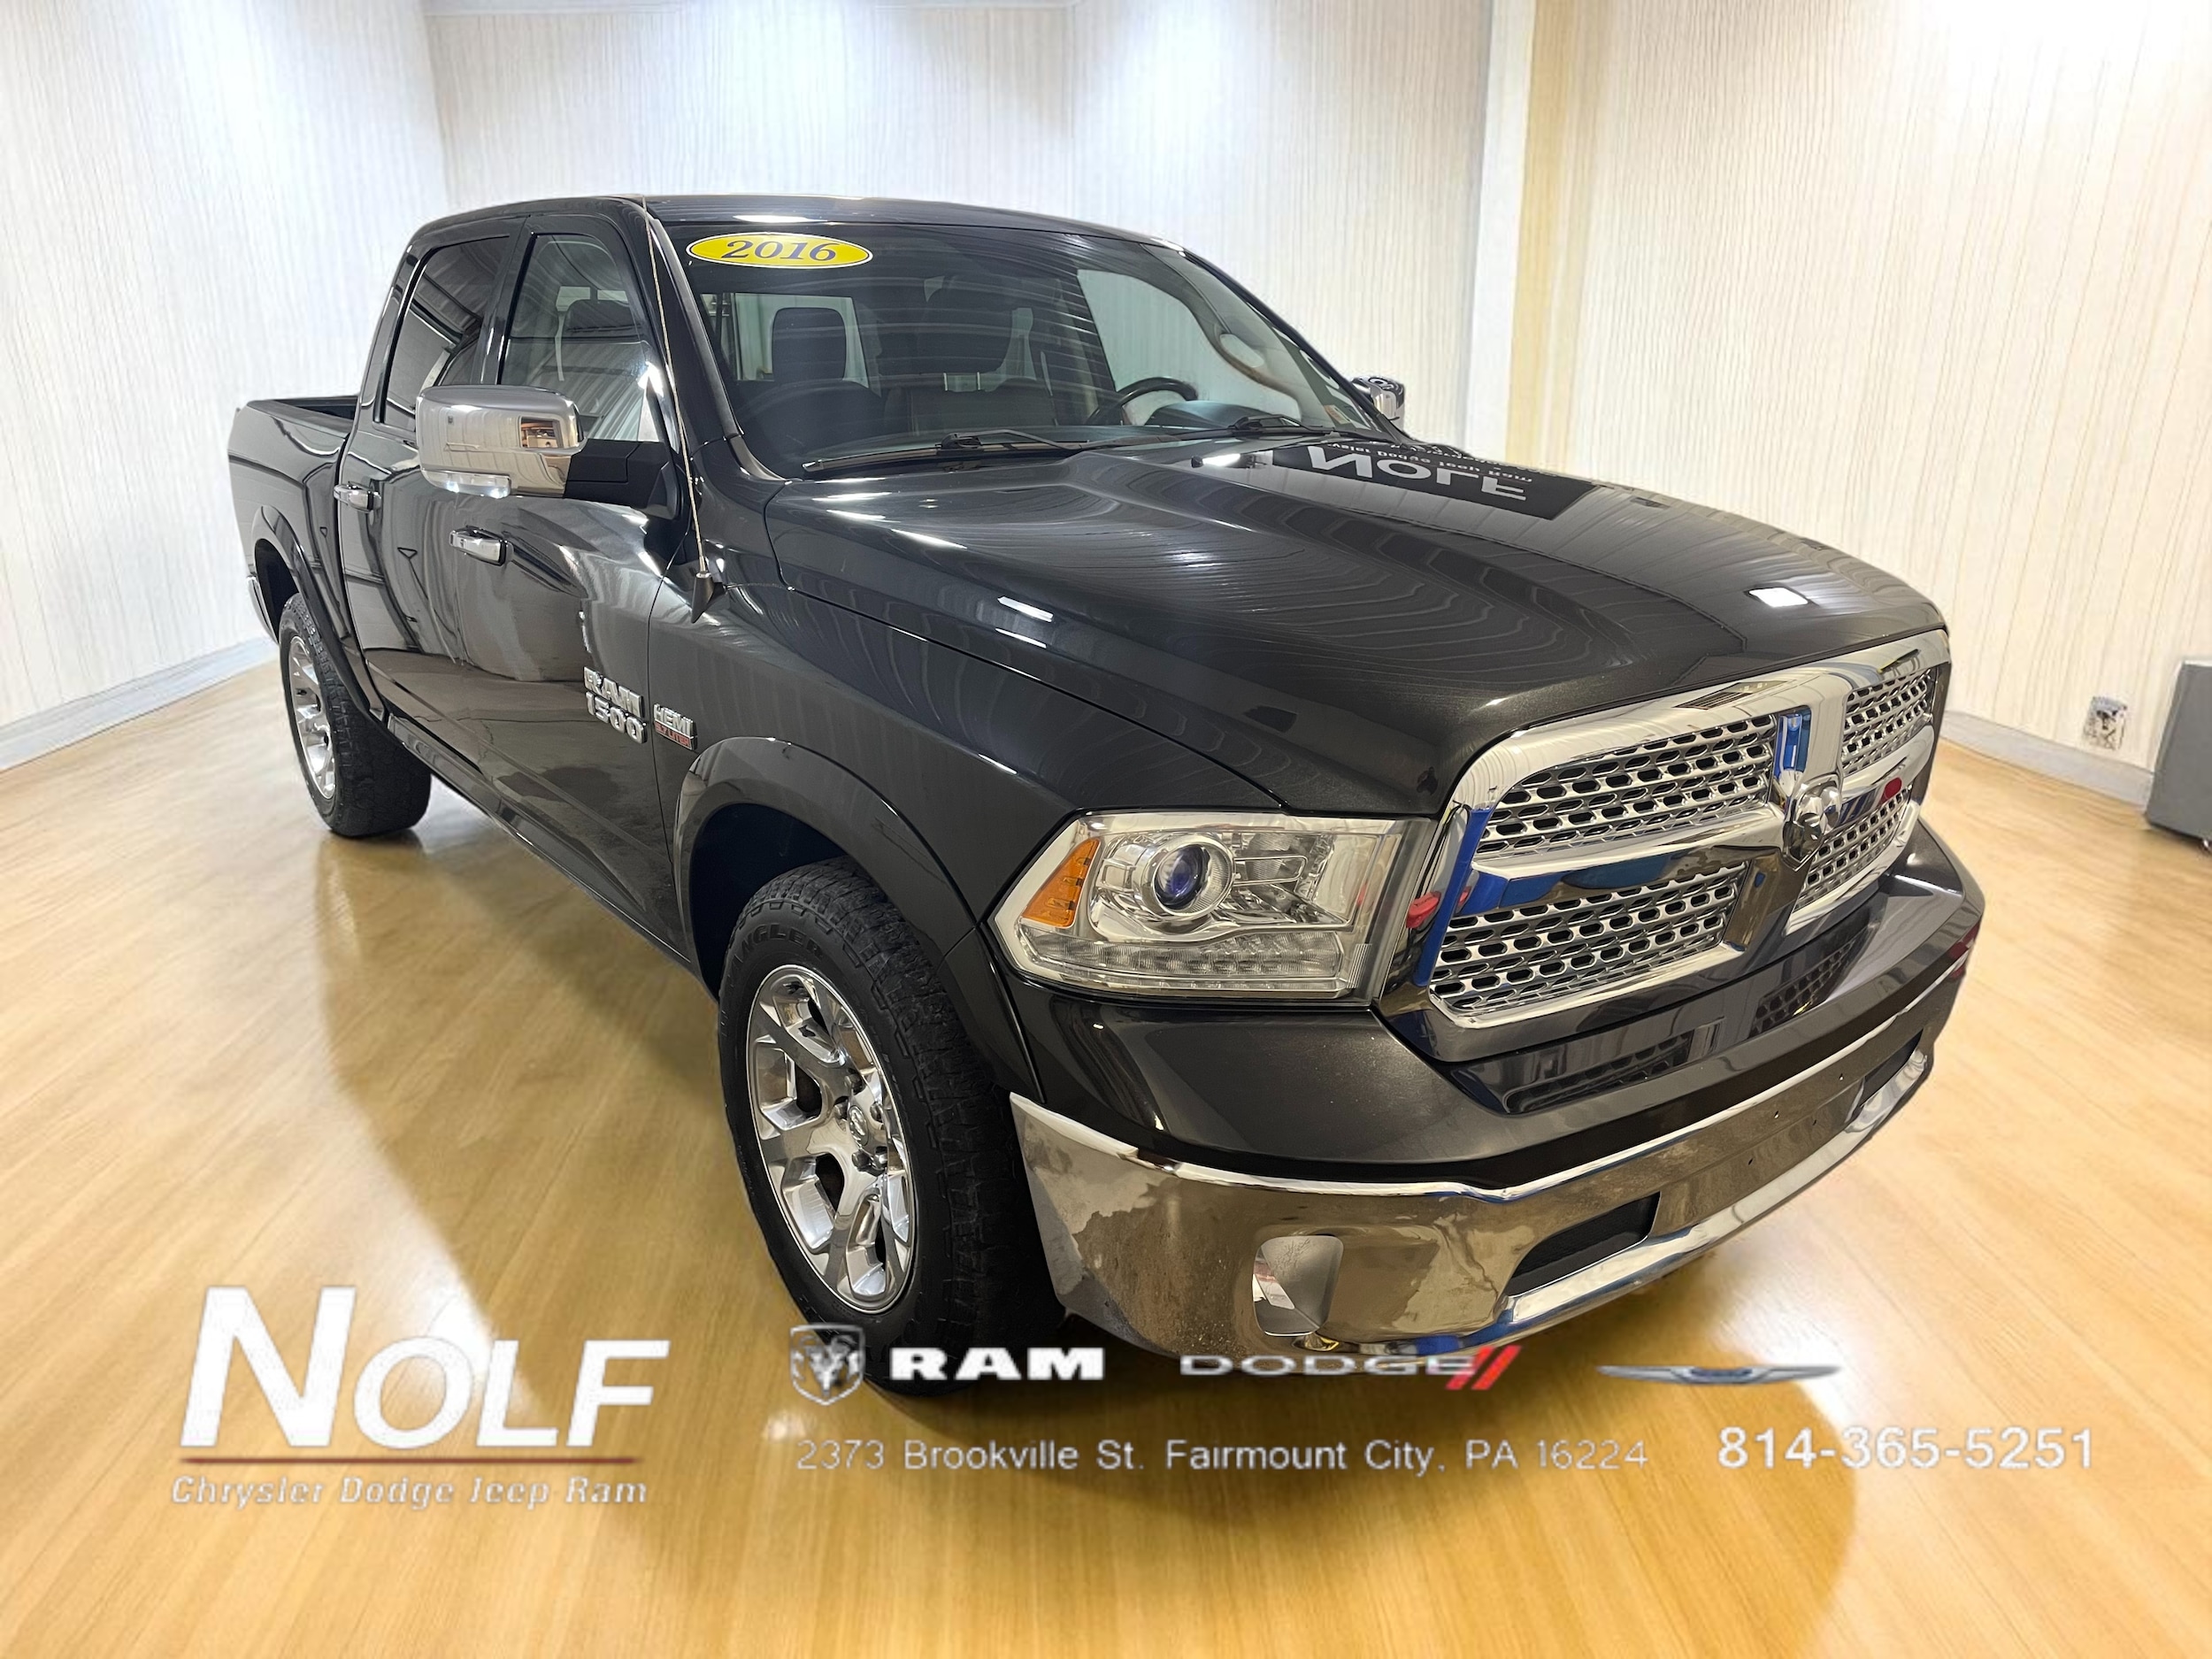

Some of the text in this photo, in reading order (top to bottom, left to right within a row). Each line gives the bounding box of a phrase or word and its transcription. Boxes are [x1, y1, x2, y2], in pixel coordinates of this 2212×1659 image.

[721, 240, 841, 261] 2016
[584, 666, 645, 719] RAM
[586, 691, 649, 744] 1500
[653, 703, 696, 740] HEMI
